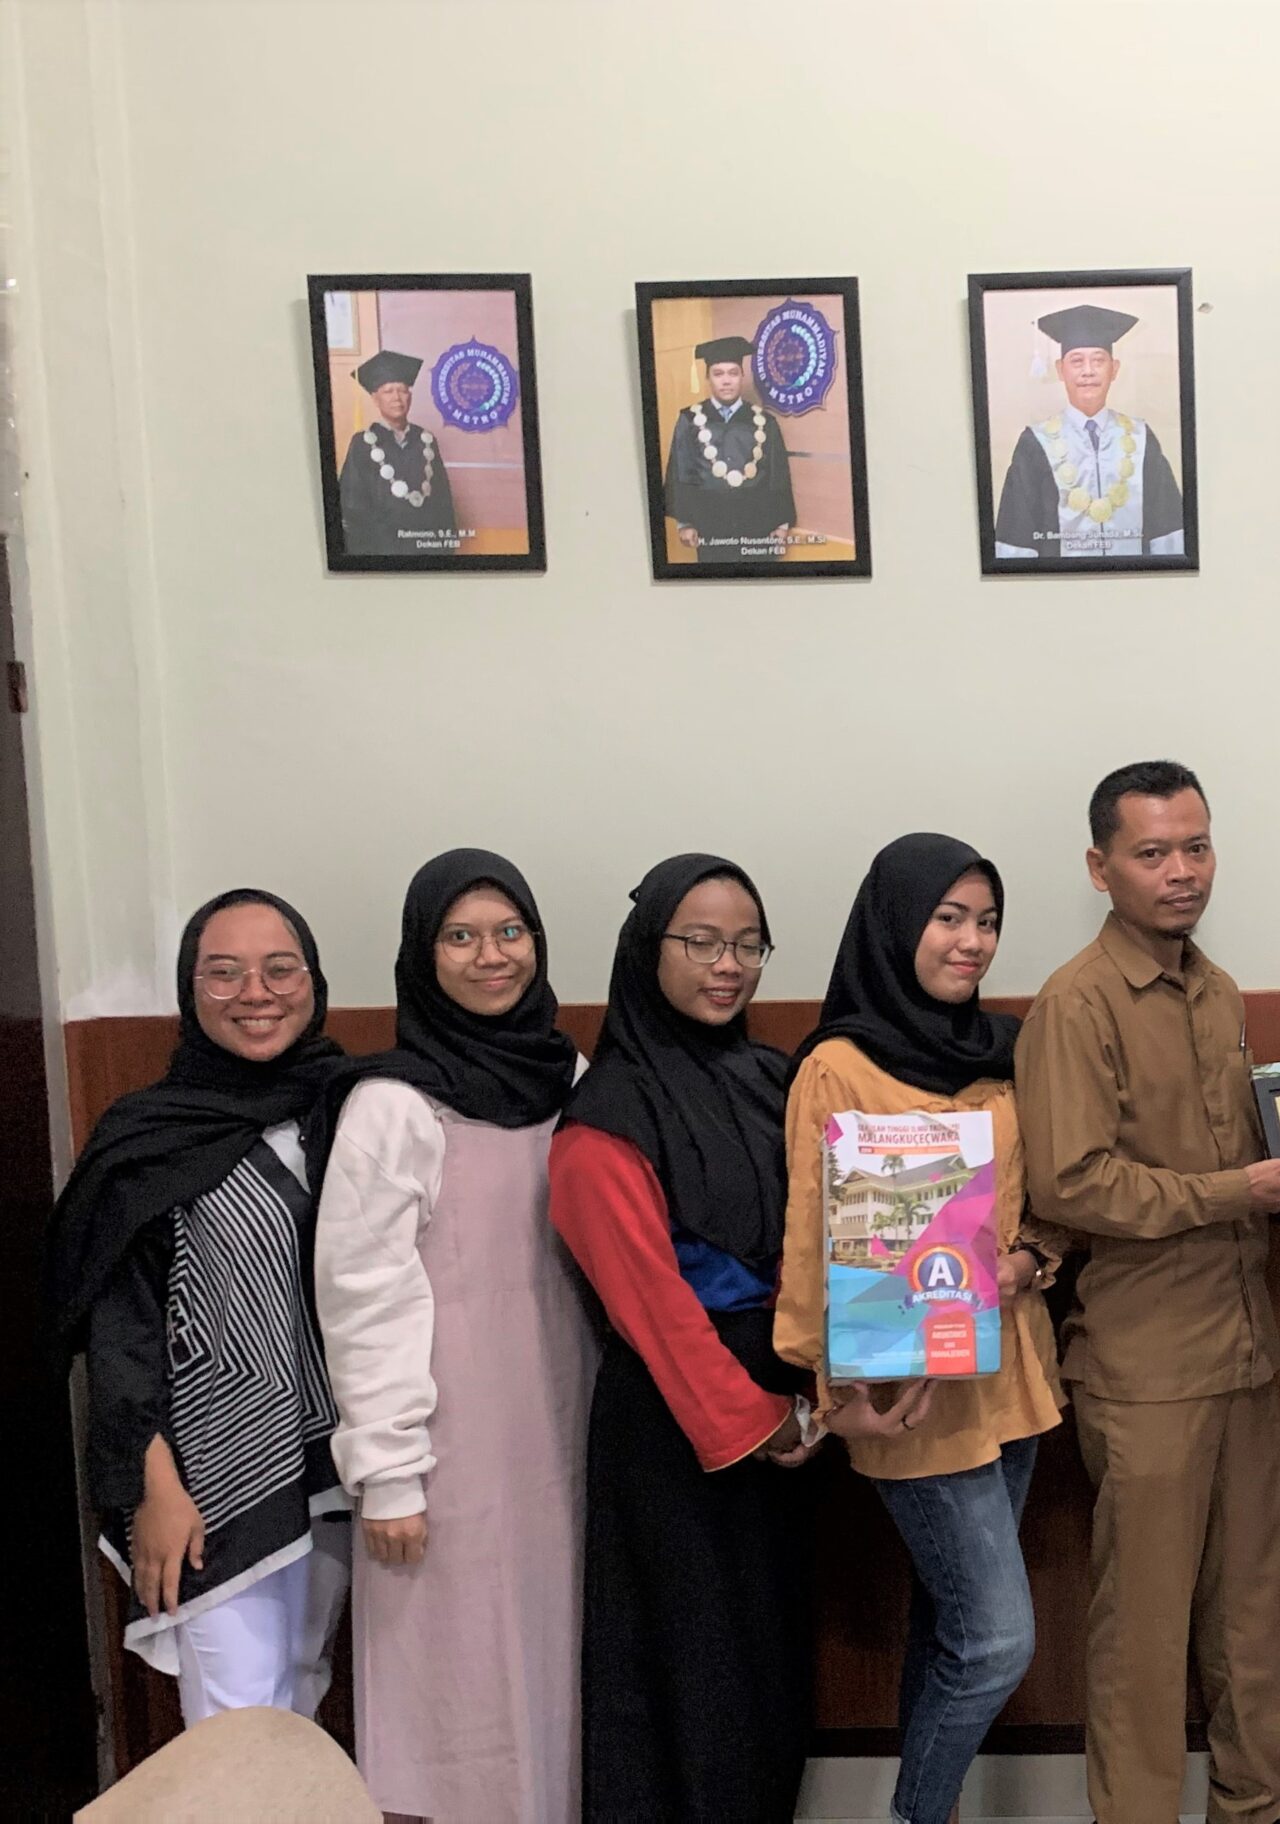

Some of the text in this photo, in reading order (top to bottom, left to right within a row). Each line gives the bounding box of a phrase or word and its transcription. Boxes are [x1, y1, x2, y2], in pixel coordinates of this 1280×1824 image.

[757, 309, 827, 381] UNIVERSITAS MUHAMMADIYAH
[438, 347, 511, 406] UNIVERSITAS MUHAMMADIYAH
[768, 386, 813, 405] METRO
[452, 408, 498, 425] METRO
[416, 539, 461, 549] Dekan FEB
[740, 546, 786, 556] Dekan FEB
[927, 1256, 955, 1288] A
[911, 1289, 973, 1304] AKREDITASI
